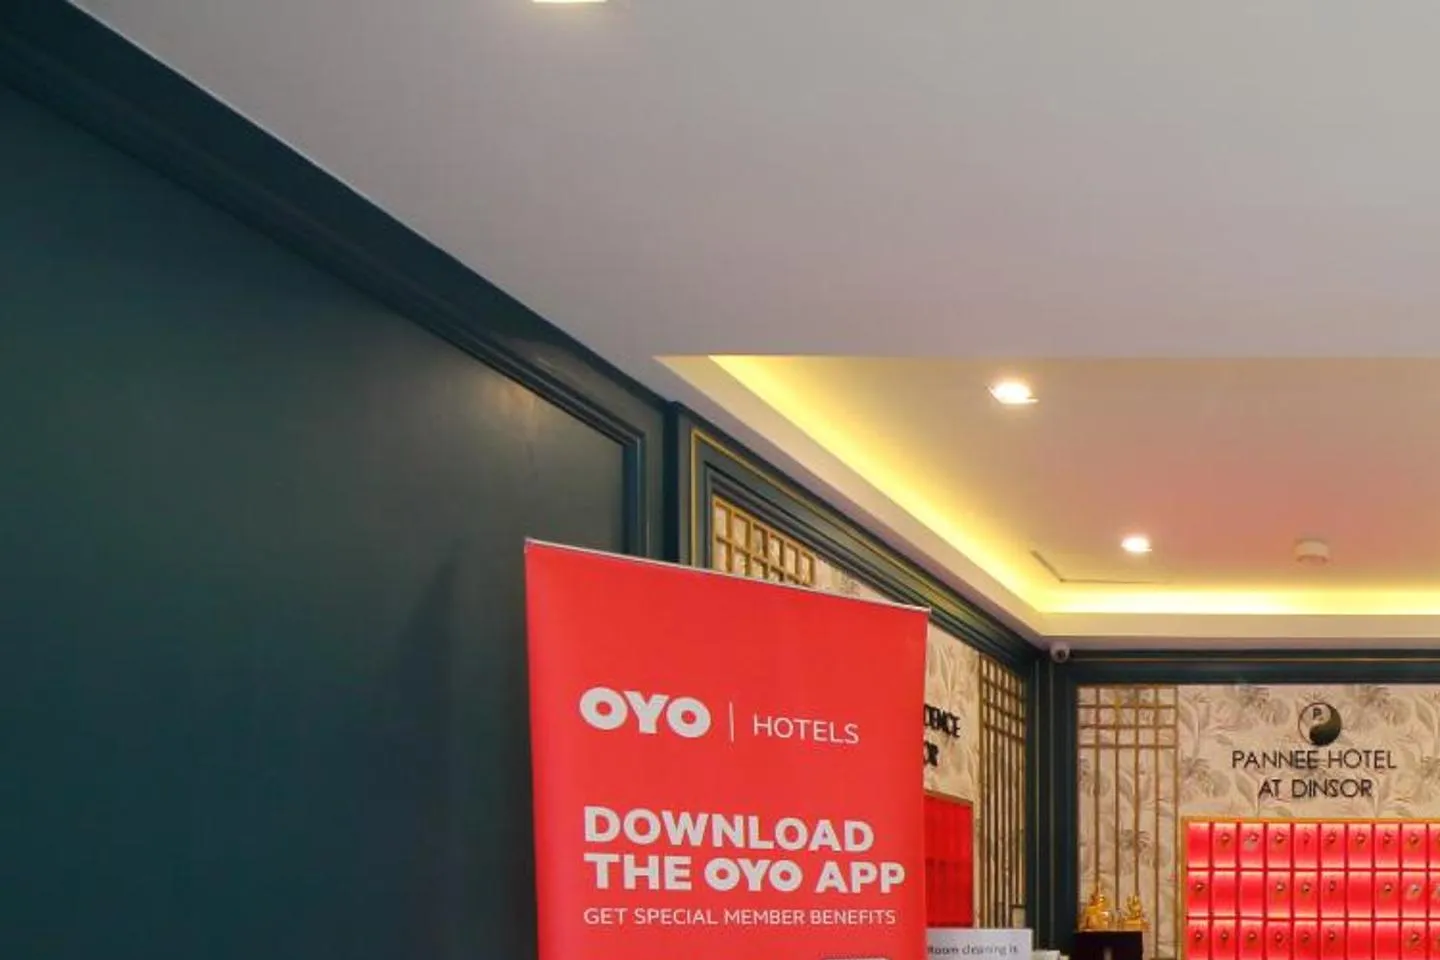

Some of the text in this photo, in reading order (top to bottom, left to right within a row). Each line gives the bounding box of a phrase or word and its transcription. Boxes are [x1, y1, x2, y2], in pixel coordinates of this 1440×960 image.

[579, 686, 860, 744] OYO HOTELS
[1231, 749, 1397, 769] PANNEE HOTEL
[1258, 779, 1373, 798] AT DINSOR
[583, 805, 875, 852] DOWNLOAD
[583, 852, 906, 894] THE OYO APP
[583, 907, 896, 926] GET SPECIAL MEMBER BENEFITS
